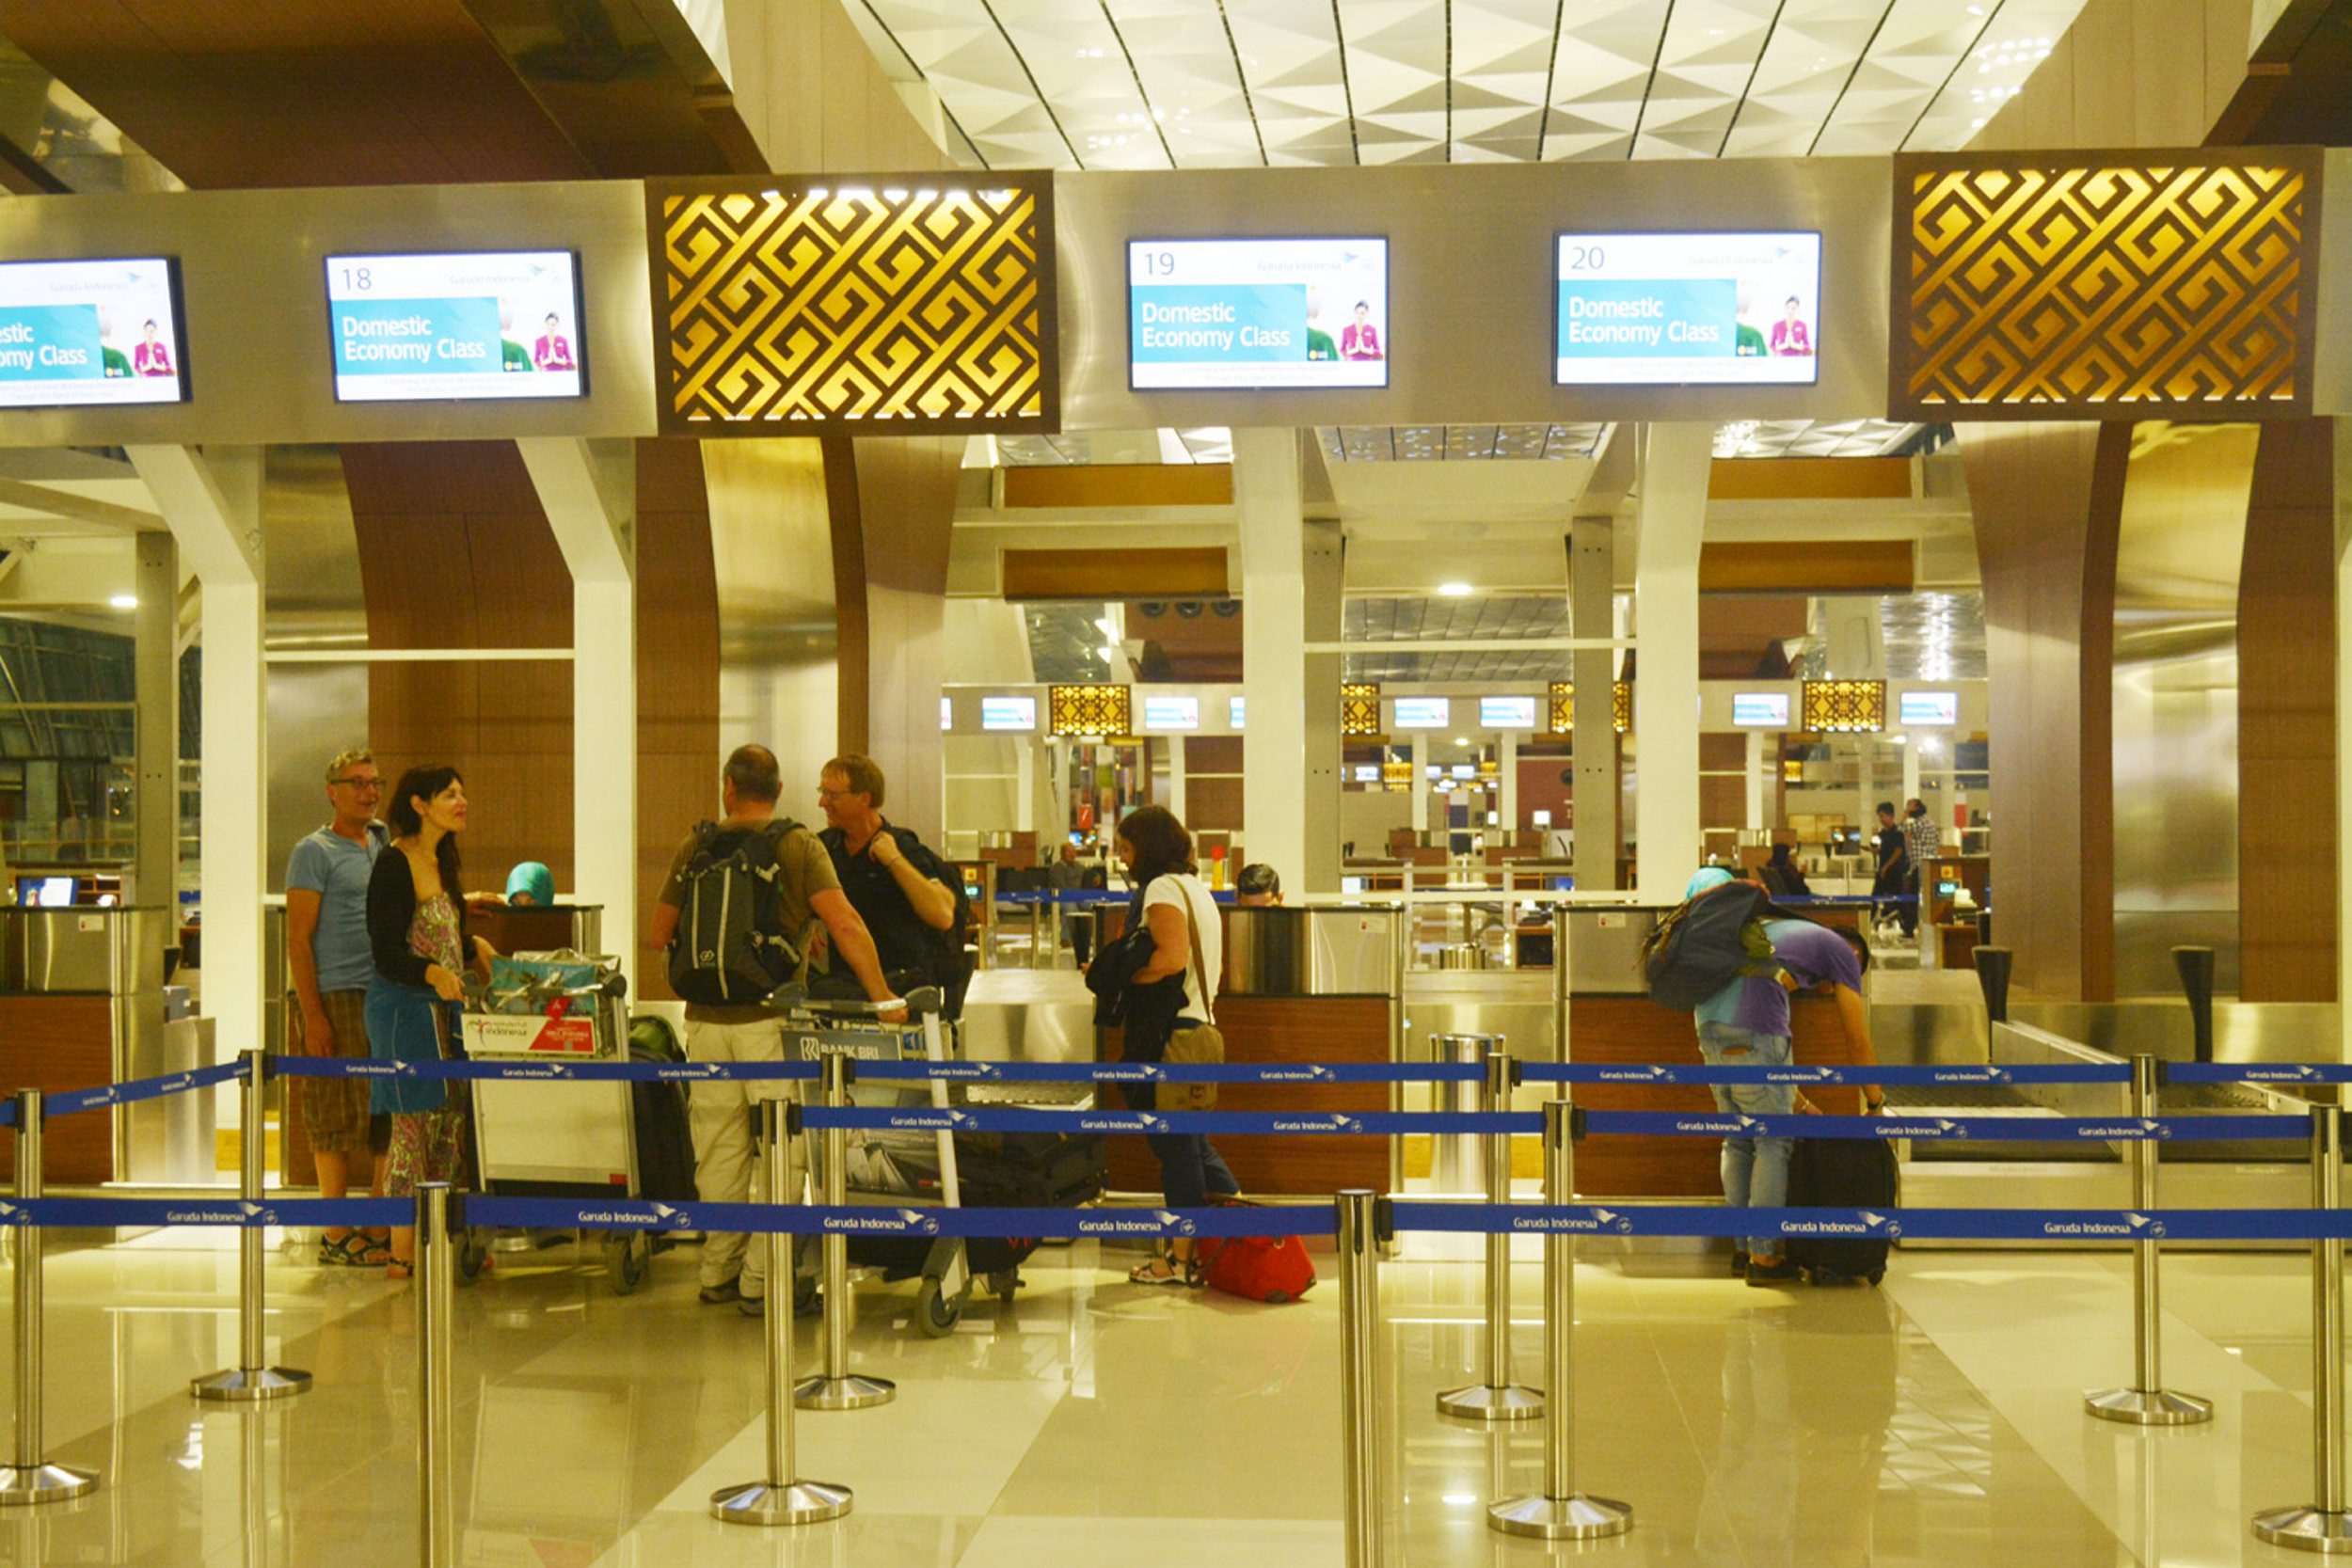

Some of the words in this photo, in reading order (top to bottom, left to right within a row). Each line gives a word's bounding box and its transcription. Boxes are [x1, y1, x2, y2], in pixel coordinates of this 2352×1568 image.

[1570, 246, 1605, 269] 20
[1144, 252, 1175, 276] 19
[343, 267, 372, 290] 18
[1142, 302, 1235, 323] Domestic
[1568, 296, 1663, 318] Domestic
[342, 315, 432, 337] Domestic
[1142, 327, 1234, 351] Economy
[1240, 325, 1291, 346] Class
[1568, 322, 1662, 346] Economy
[1668, 321, 1720, 341] Class
[40, 345, 87, 365] Class
[344, 340, 432, 363] Economy
[437, 338, 486, 358] Class
[820, 1043, 856, 1058] BANK
[858, 1045, 880, 1060] BRI
[891, 1117, 917, 1127] Garuda
[918, 1117, 952, 1127] Indonesia
[1081, 1119, 1107, 1130] Garuda
[1109, 1120, 1143, 1130] Indonesia
[1274, 1120, 1300, 1132] Garuda
[1302, 1122, 1336, 1131] Indonesia
[1677, 1121, 1705, 1132] Garuda
[1706, 1122, 1740, 1132] Indonesia
[1875, 1126, 1903, 1135] Garuda
[1905, 1127, 1940, 1136] Indonesia
[2078, 1128, 2107, 1137] Garuda
[2108, 1128, 2144, 1136] Indonesia
[167, 1212, 199, 1222] Garuda
[202, 1212, 245, 1222] Indonesia
[579, 1212, 612, 1222] Garuda
[613, 1212, 657, 1223] Indonesia
[824, 1217, 858, 1228] Garuda
[861, 1219, 904, 1229] Indonesia
[1513, 1217, 1549, 1227] Garuda
[1551, 1218, 1597, 1228] Indonesia
[1079, 1221, 1114, 1231] Garuda
[1116, 1221, 1161, 1231] Indonesia
[1781, 1222, 1817, 1232] Garuda
[1819, 1223, 1866, 1232] Indonesia
[2044, 1222, 2080, 1233] Garuda
[2083, 1224, 2130, 1233] Indonesia
